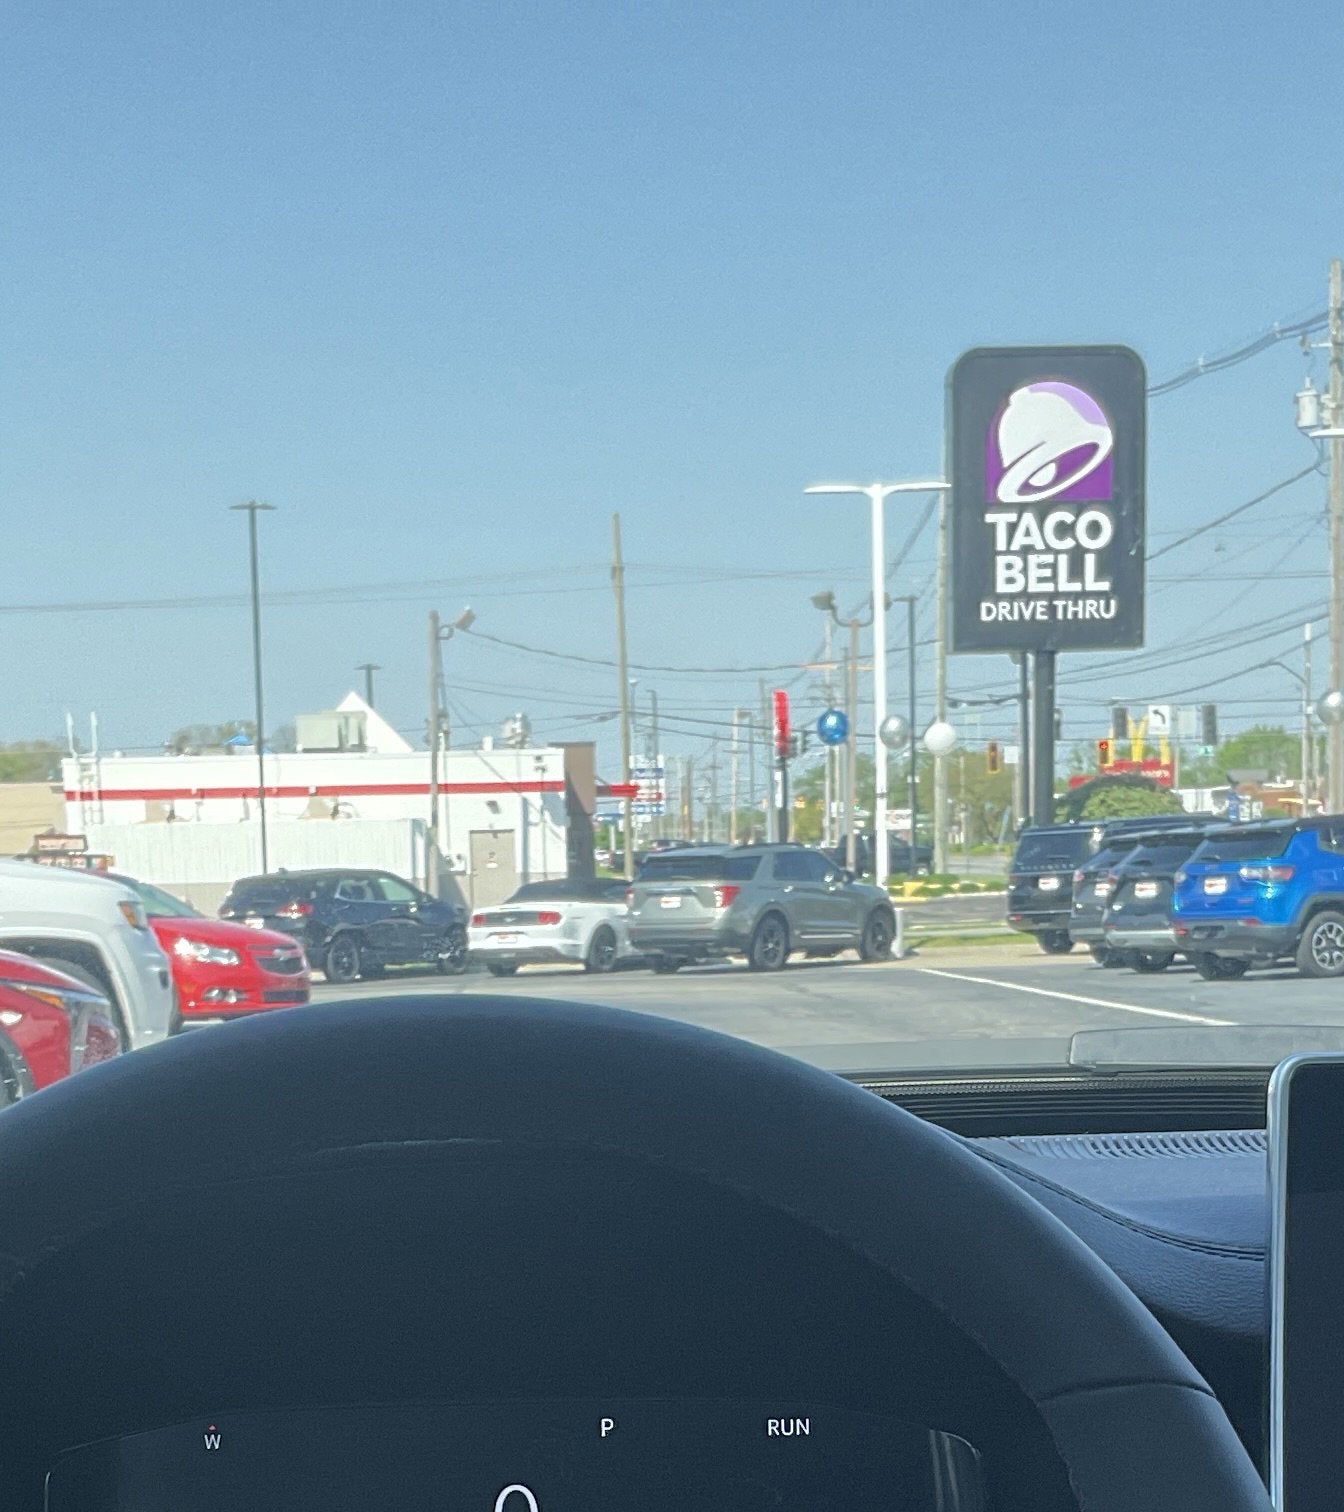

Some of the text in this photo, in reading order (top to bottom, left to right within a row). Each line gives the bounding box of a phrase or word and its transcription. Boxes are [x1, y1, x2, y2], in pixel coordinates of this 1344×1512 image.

[985, 510, 1112, 551] TACO
[995, 553, 1110, 593] BELL
[980, 599, 1117, 621] DRIVE THRU
[600, 1418, 615, 1438] P
[767, 1417, 811, 1438] RUN
[203, 1433, 222, 1450] W
